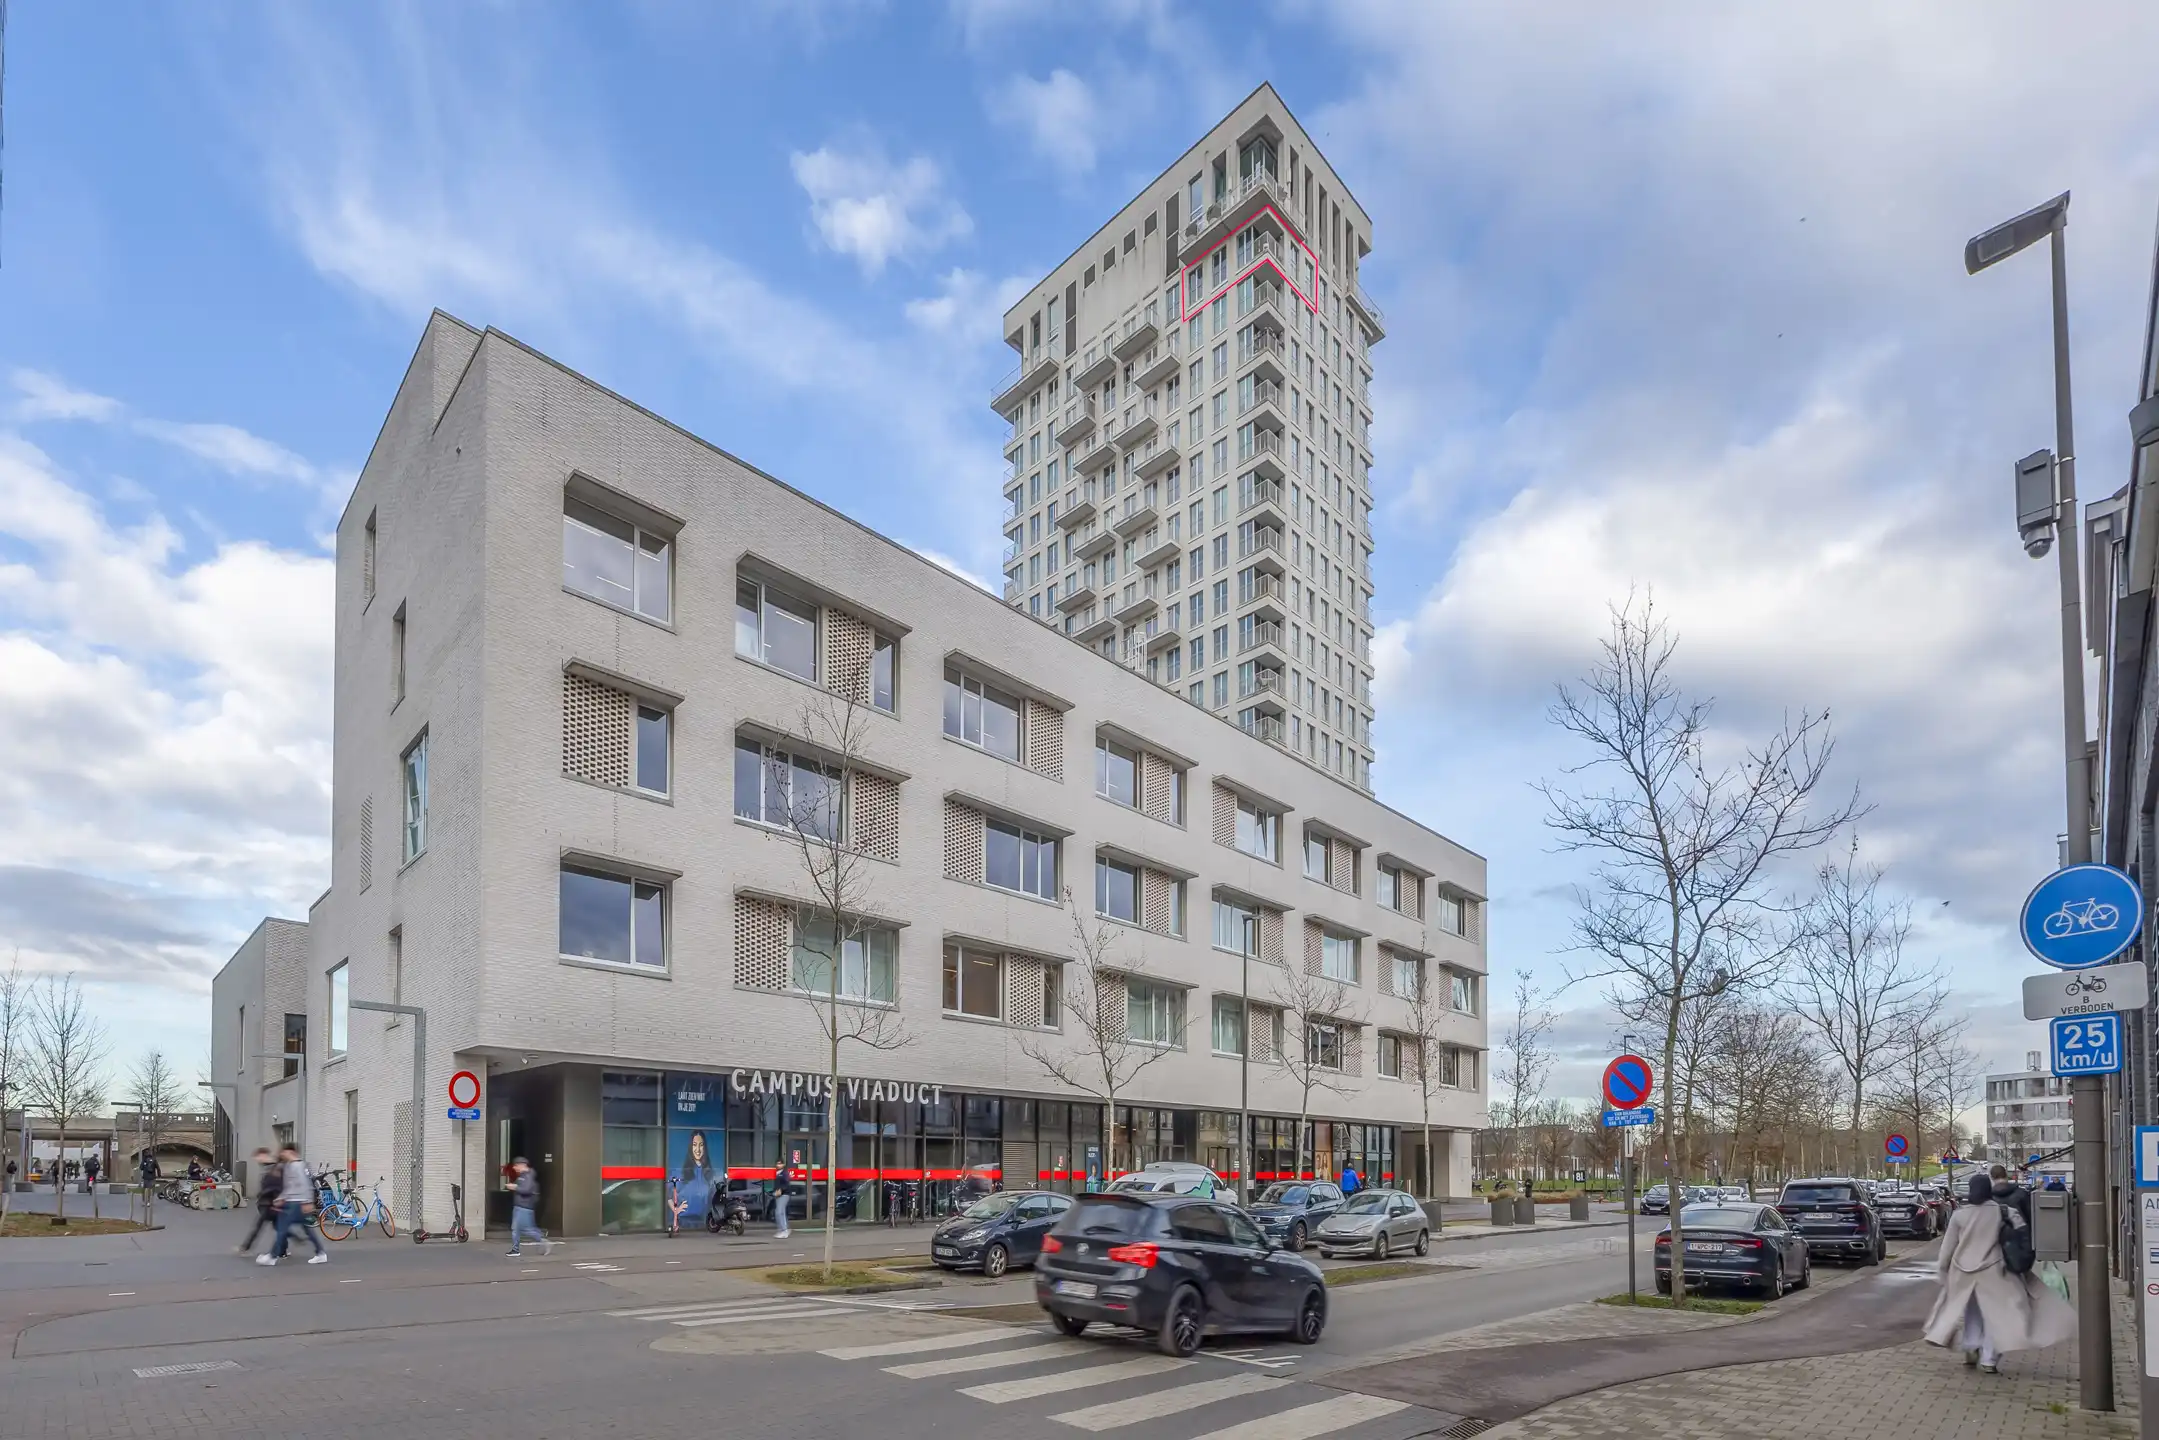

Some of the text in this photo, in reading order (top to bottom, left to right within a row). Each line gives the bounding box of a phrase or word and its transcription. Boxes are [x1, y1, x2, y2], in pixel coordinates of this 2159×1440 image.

[2060, 1002, 2114, 1015] VERBODEN
[2082, 996, 2090, 1004] B
[2064, 1022, 2106, 1050] 25
[2060, 1049, 2112, 1068] km/u
[731, 1068, 834, 1098] CAMPUS
[846, 1078, 943, 1105] VIADUCT
